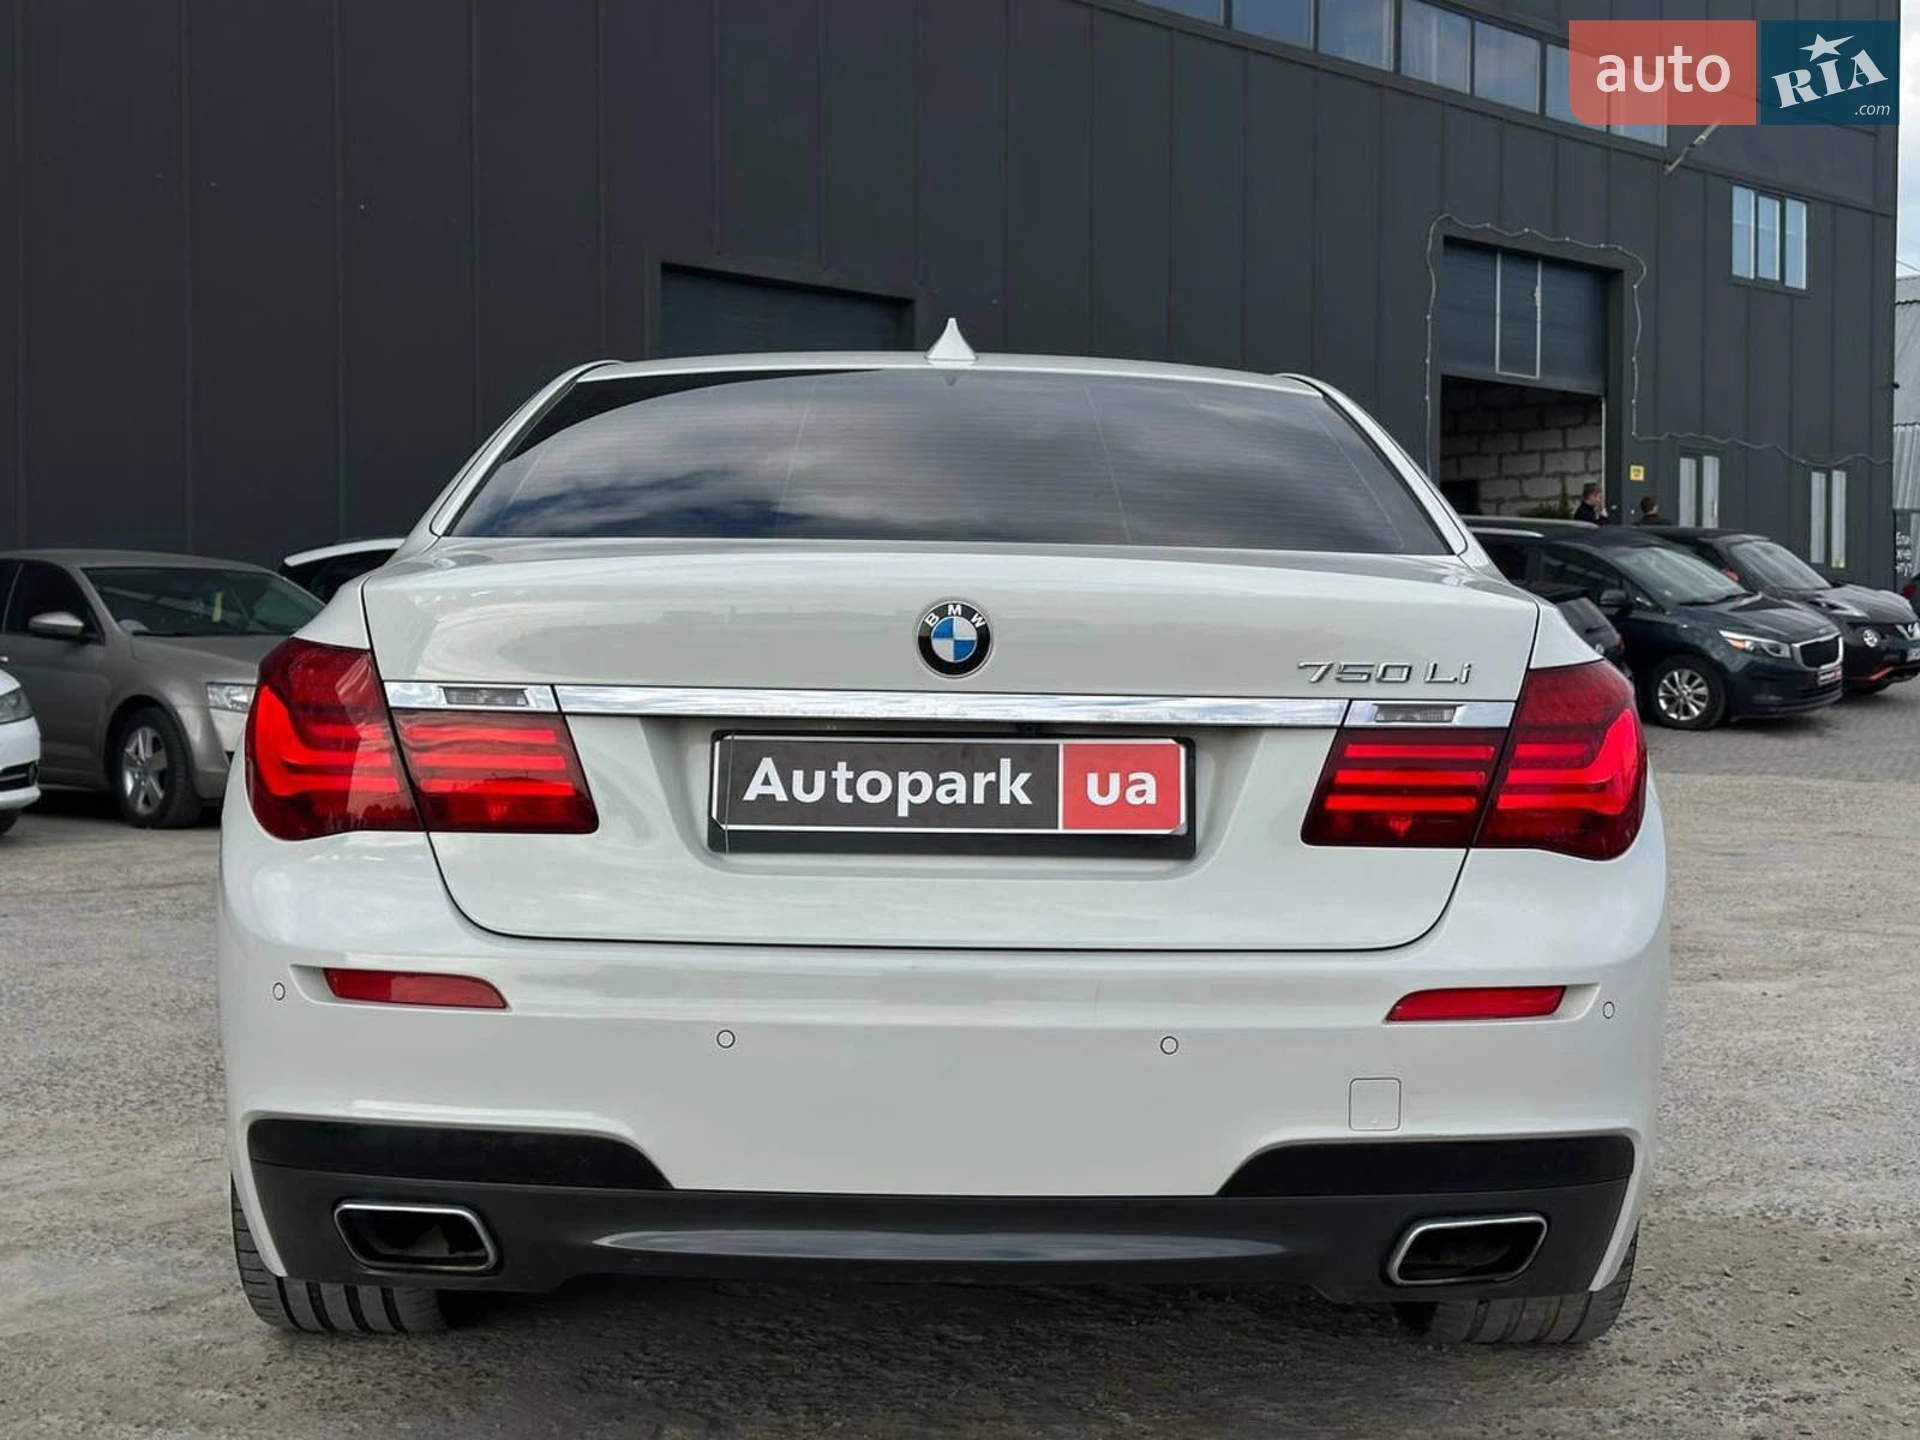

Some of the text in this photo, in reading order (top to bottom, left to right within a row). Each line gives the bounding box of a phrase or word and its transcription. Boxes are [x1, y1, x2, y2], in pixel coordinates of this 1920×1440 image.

[924, 604, 986, 628] BMW
[1298, 661, 1473, 685] 750 Li
[743, 757, 1158, 817] Autopark ua
